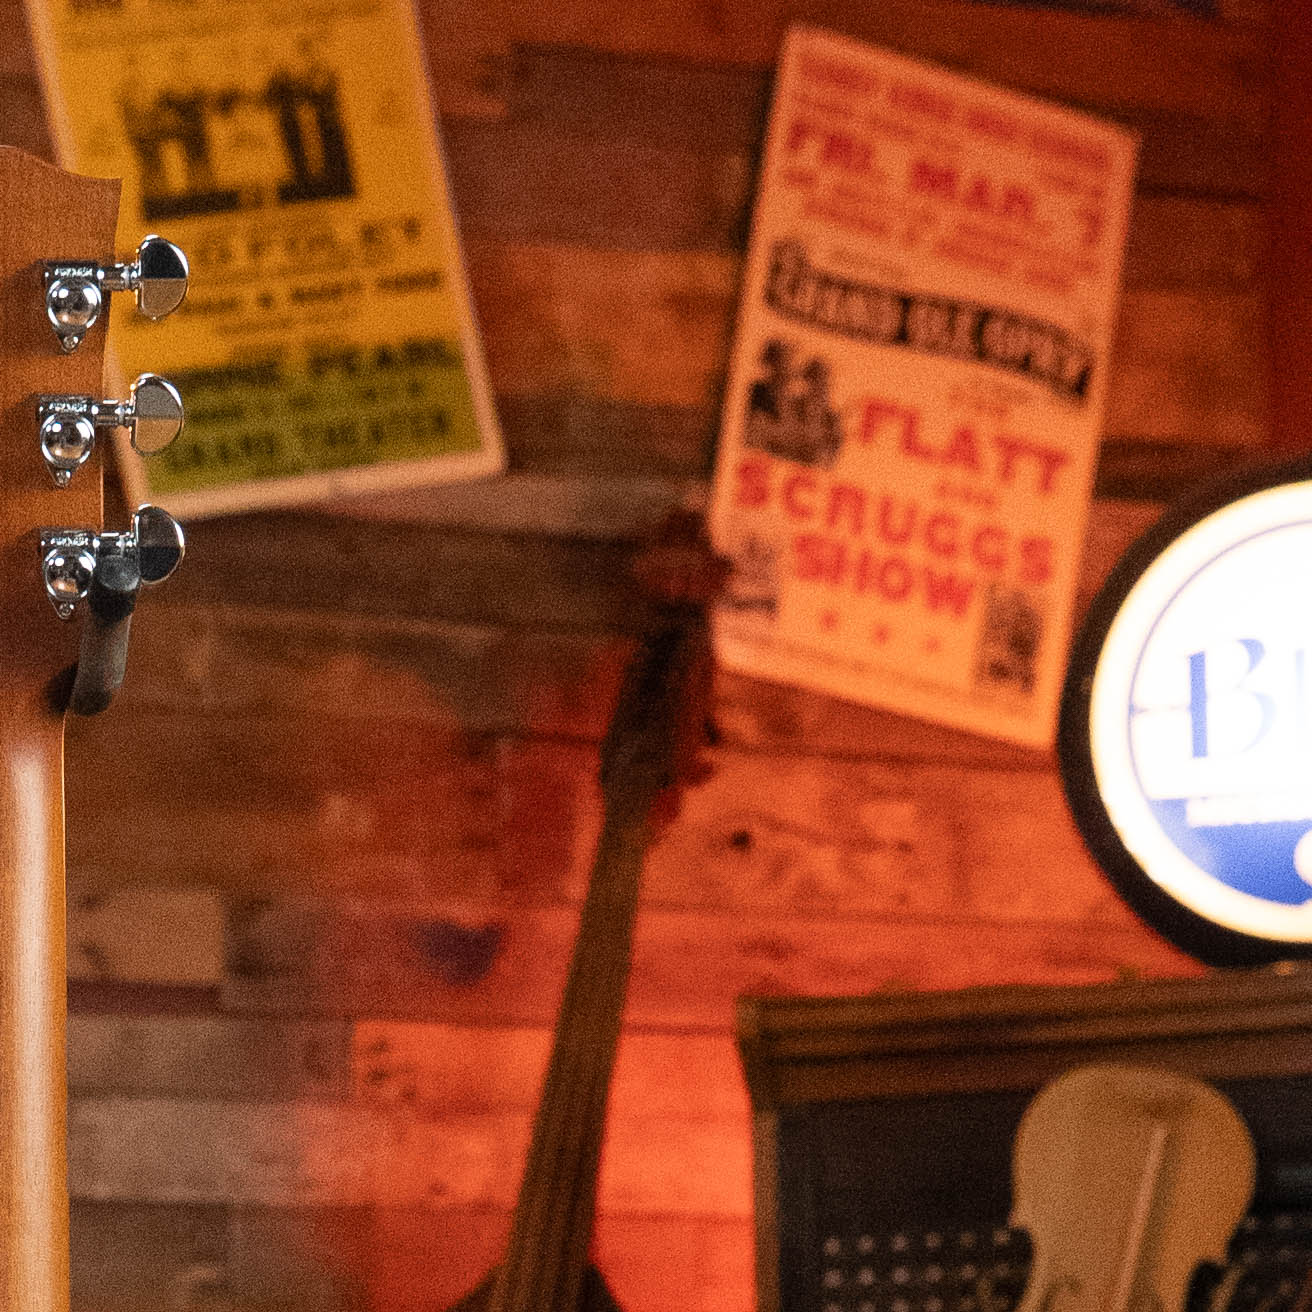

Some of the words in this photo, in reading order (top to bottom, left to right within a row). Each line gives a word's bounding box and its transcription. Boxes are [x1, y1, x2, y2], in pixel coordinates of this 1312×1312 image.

[856, 396, 1070, 494] FLATT
[738, 458, 1054, 586] SCRUGGS
[794, 534, 974, 620] SHOW
